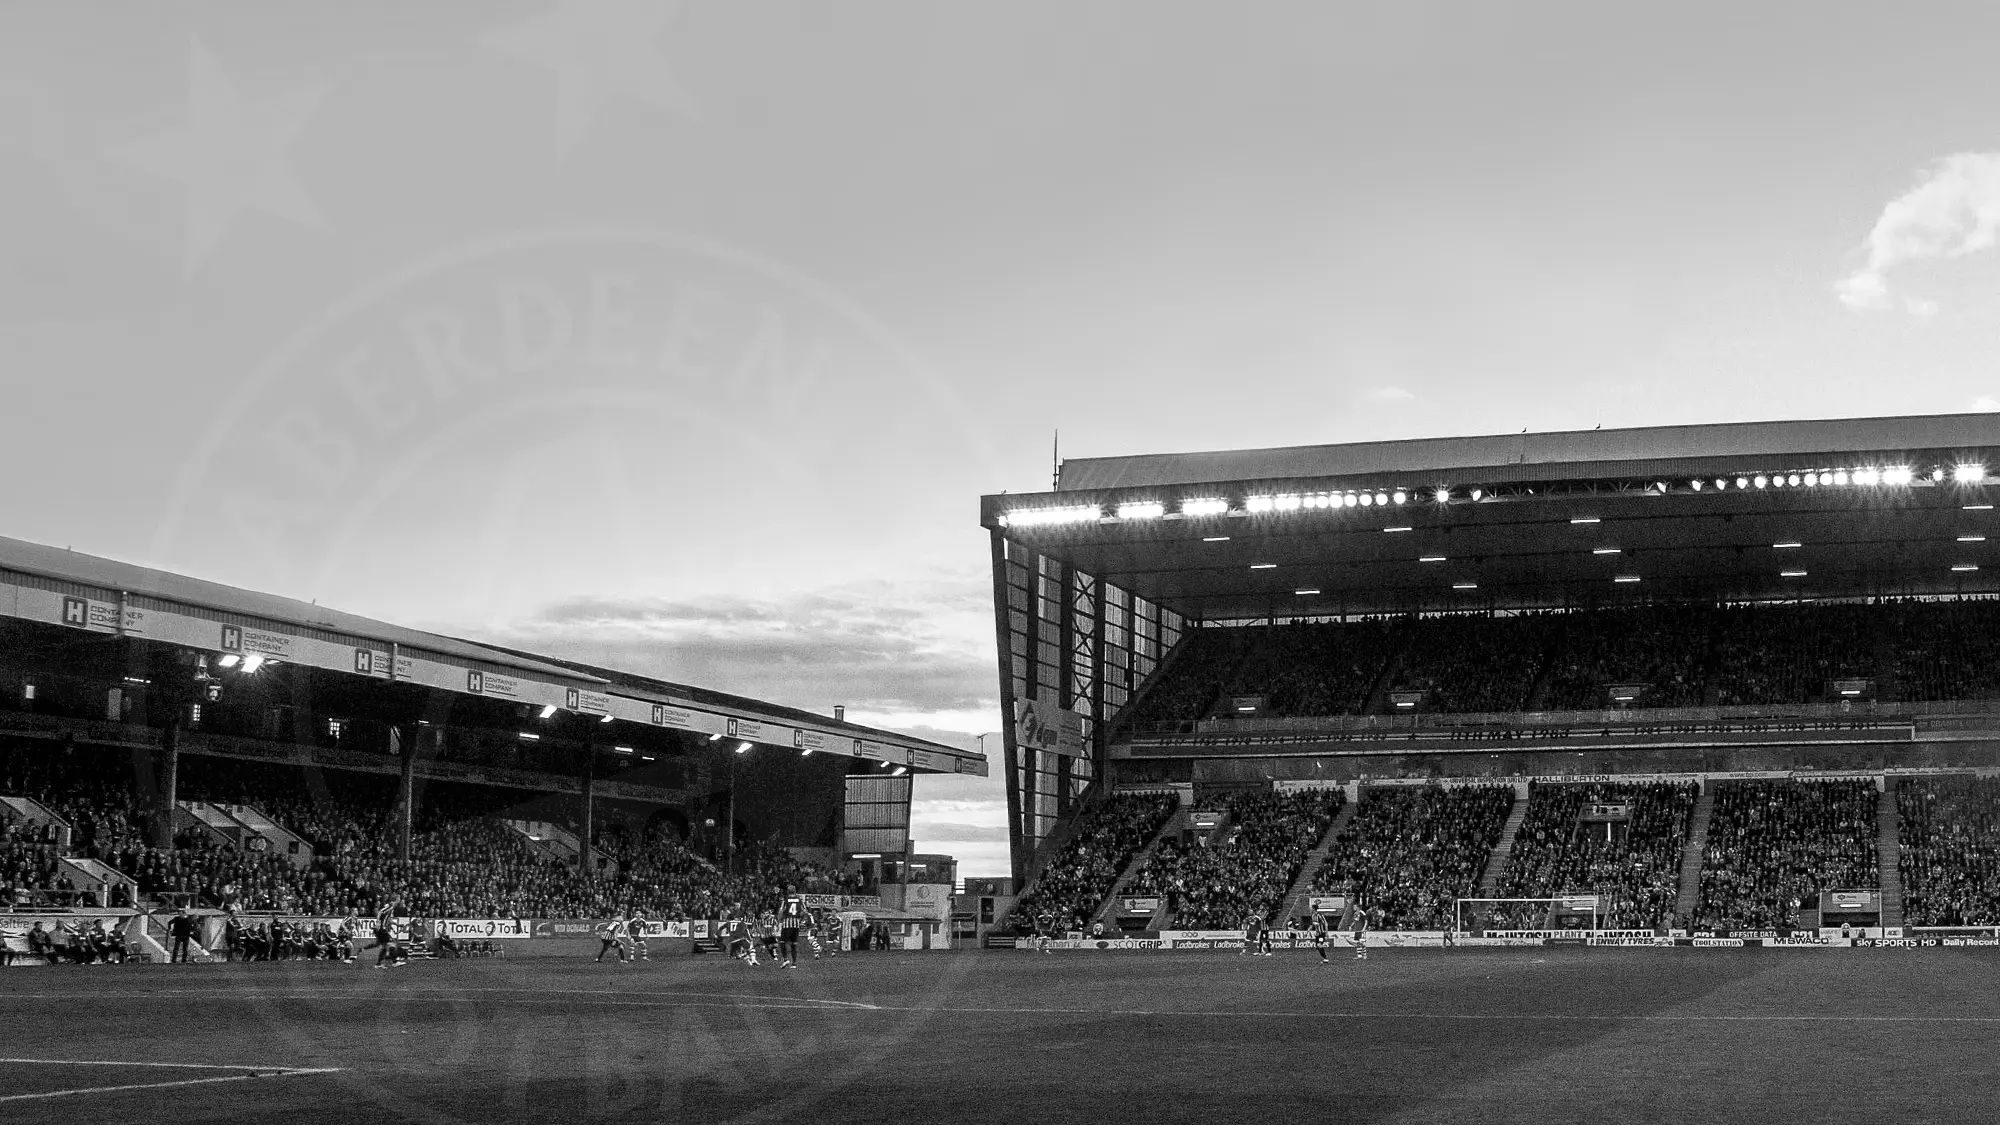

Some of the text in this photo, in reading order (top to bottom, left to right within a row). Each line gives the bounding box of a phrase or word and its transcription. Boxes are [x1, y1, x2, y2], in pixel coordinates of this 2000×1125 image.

[788, 903, 797, 915] 4
[449, 922, 484, 934] TOTAL
[498, 923, 529, 934] TOTL
[1760, 930, 1778, 938] DATA
[1177, 940, 1245, 949] Ladbrokes Ladbroke
[1295, 940, 1330, 949] Ladbres
[1628, 937, 1654, 945] TYRES
[1856, 938, 1937, 948] sky SPORTS HD
[1943, 938, 1999, 947] Daily Record
